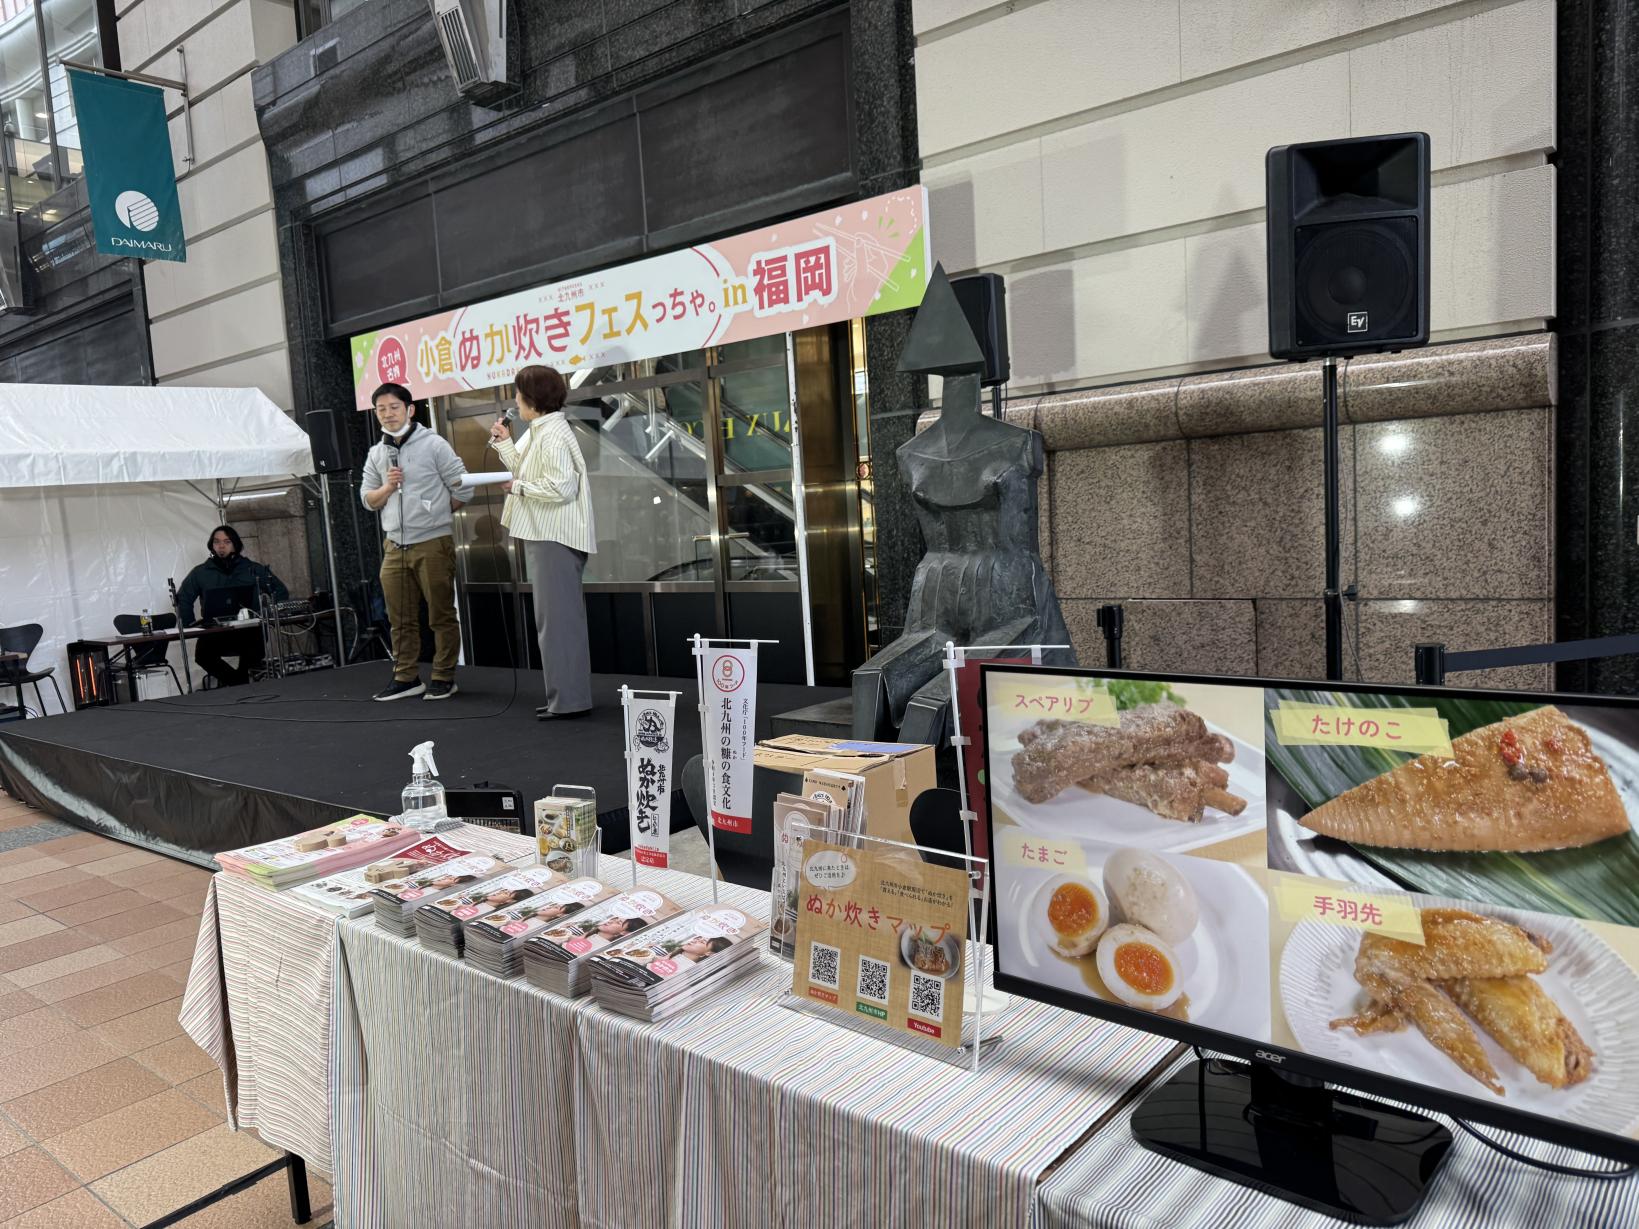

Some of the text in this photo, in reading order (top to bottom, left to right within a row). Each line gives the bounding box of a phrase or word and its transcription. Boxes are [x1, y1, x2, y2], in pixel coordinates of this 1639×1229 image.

[111, 237, 172, 252] DAIMARU
[1014, 692, 1094, 716] スペアリブ
[1311, 713, 1403, 740] たけのこ
[720, 697, 732, 810] 北九州の糠の食文化
[636, 757, 659, 834] ぬか炊き
[1020, 841, 1068, 865] たまご
[806, 893, 951, 944] ぬか炊きマップ
[1313, 894, 1383, 927] 手羽先
[1254, 1048, 1287, 1065] acer
